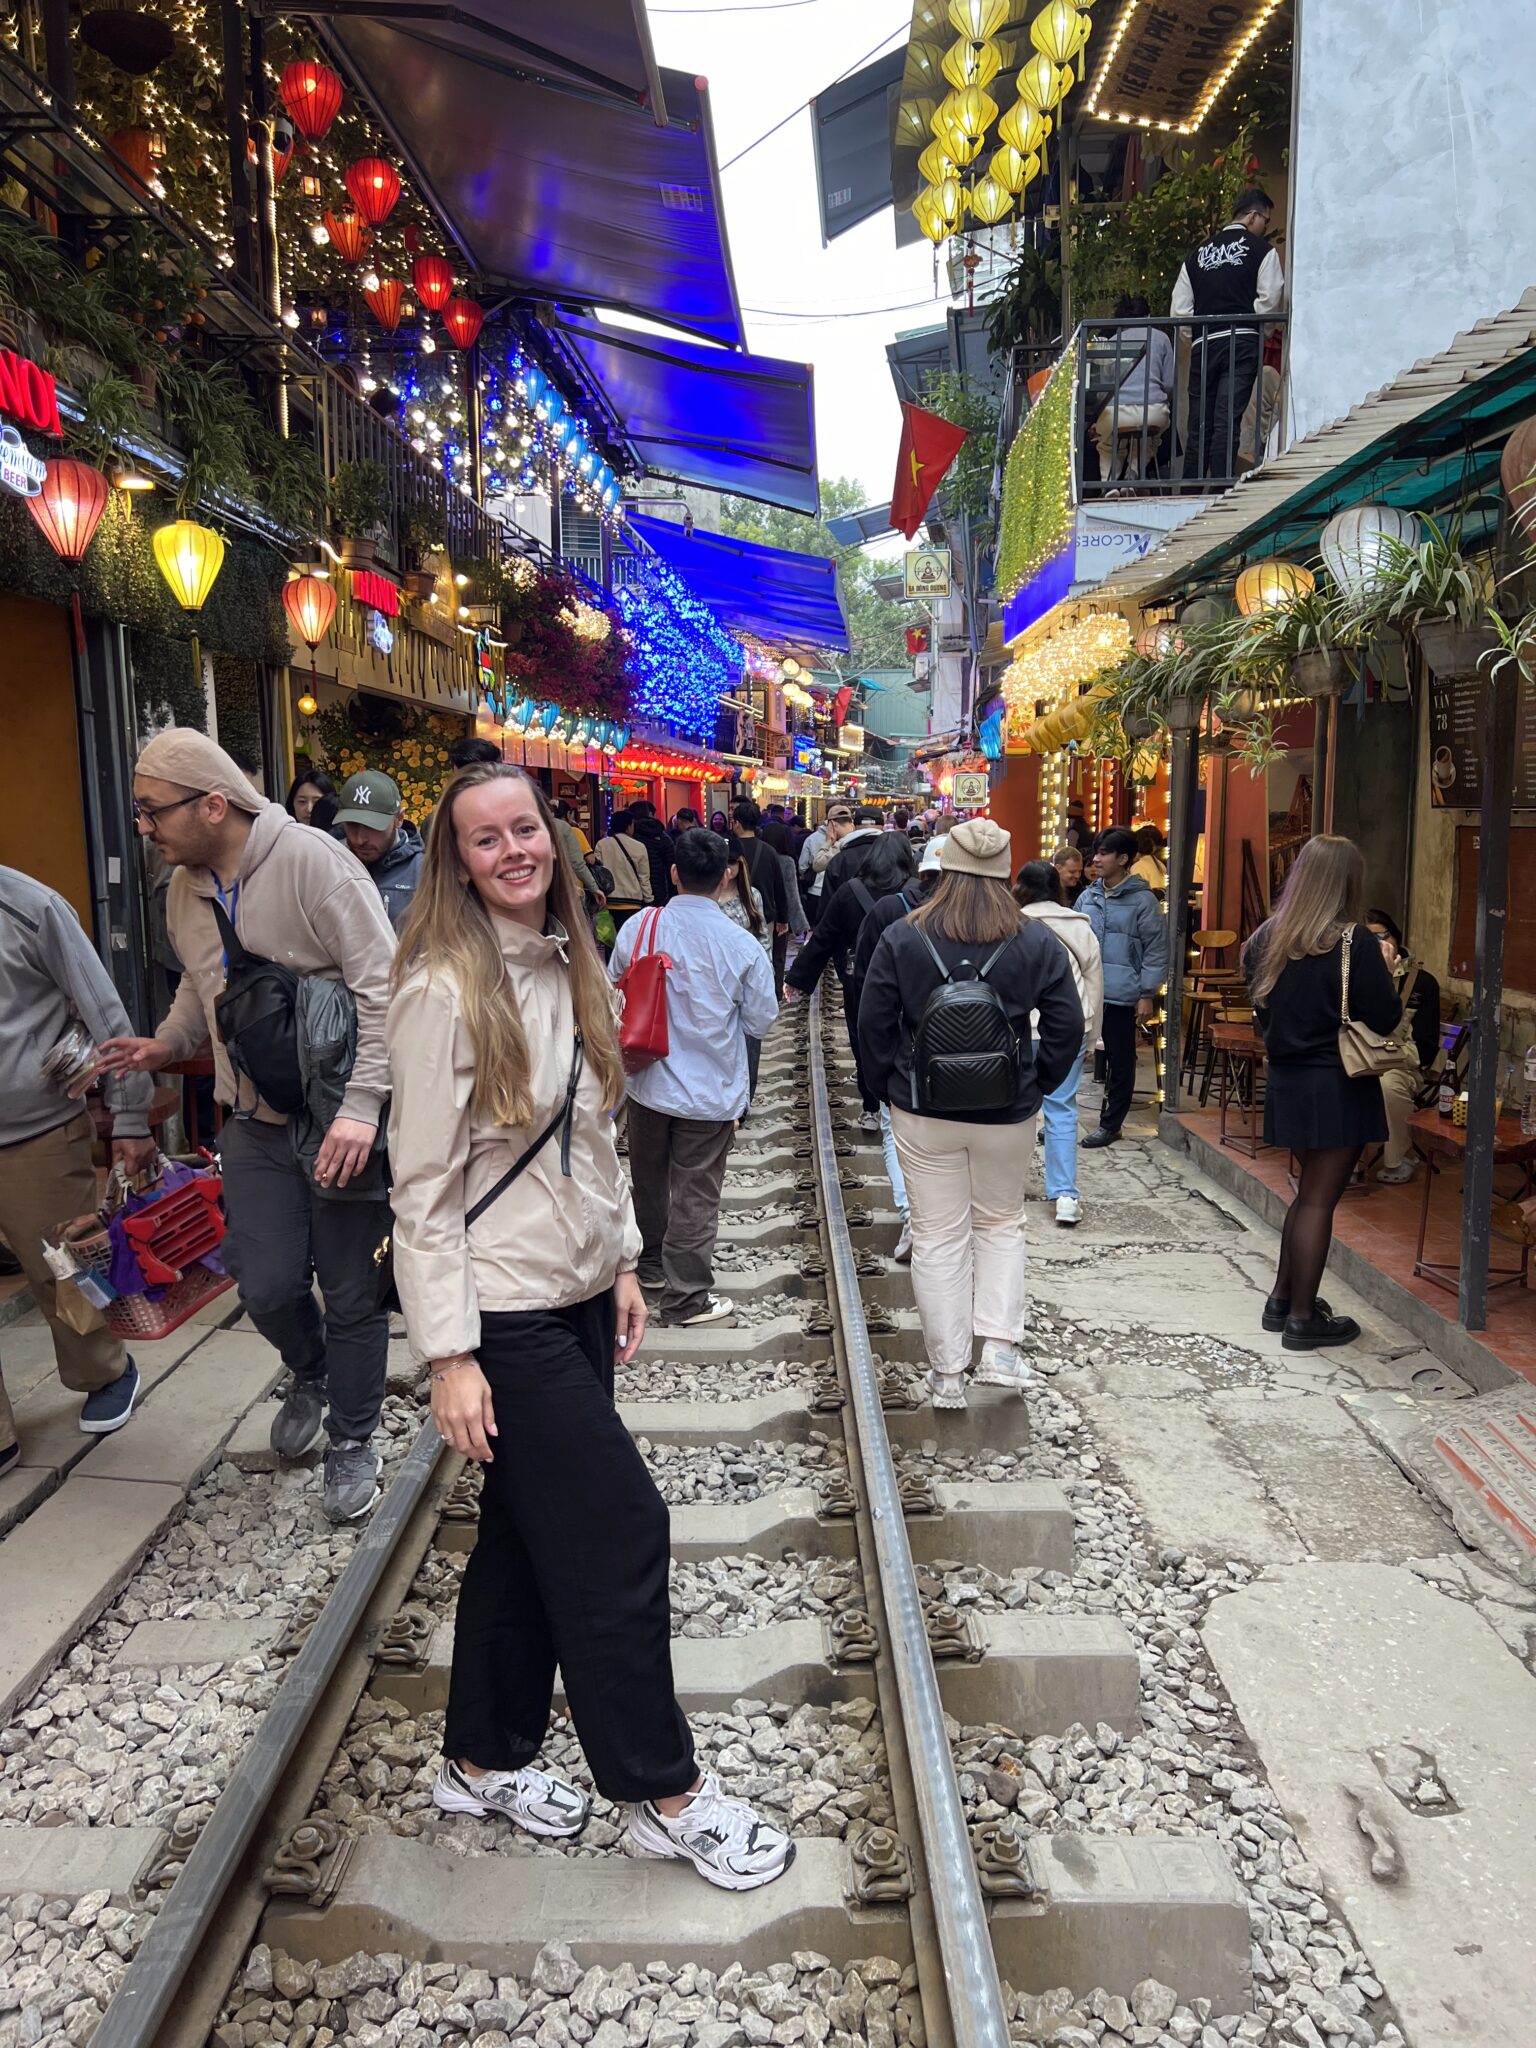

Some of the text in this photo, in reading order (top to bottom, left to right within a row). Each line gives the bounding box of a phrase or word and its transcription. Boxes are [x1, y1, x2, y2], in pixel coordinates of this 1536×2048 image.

[3, 467, 27, 490] BEER
[1436, 714, 1448, 730] 78
[353, 785, 371, 804] NY
[689, 1834, 718, 1856] N
